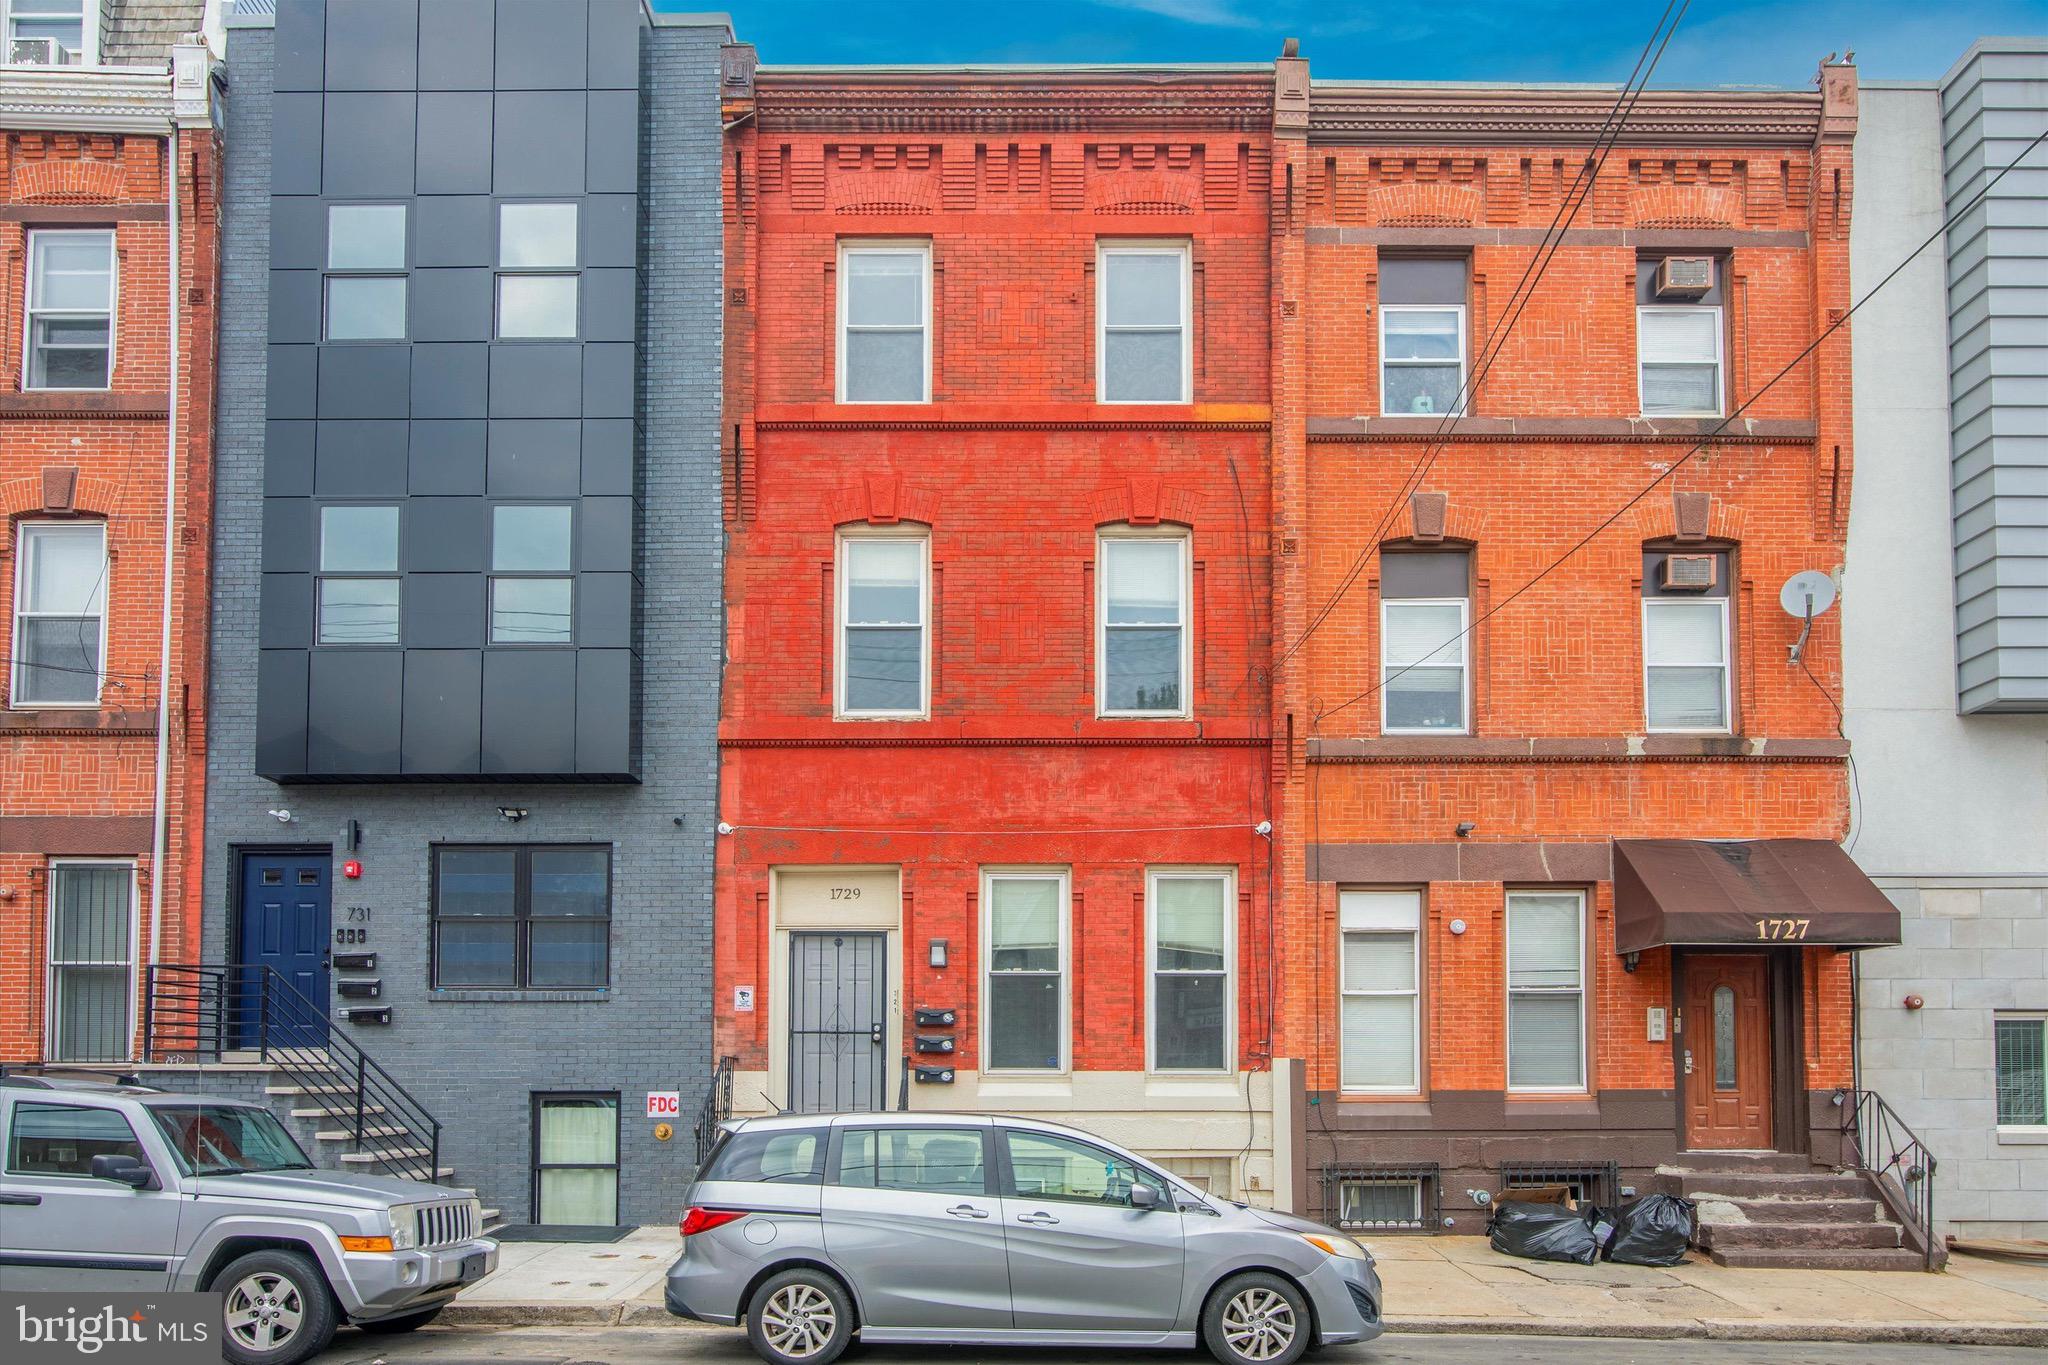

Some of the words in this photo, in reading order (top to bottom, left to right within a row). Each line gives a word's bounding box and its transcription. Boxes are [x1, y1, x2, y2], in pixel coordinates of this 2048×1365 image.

[830, 888, 861, 900] 1729
[347, 907, 371, 922] 731
[1755, 919, 1810, 940] 1727
[648, 1096, 678, 1113] FDC
